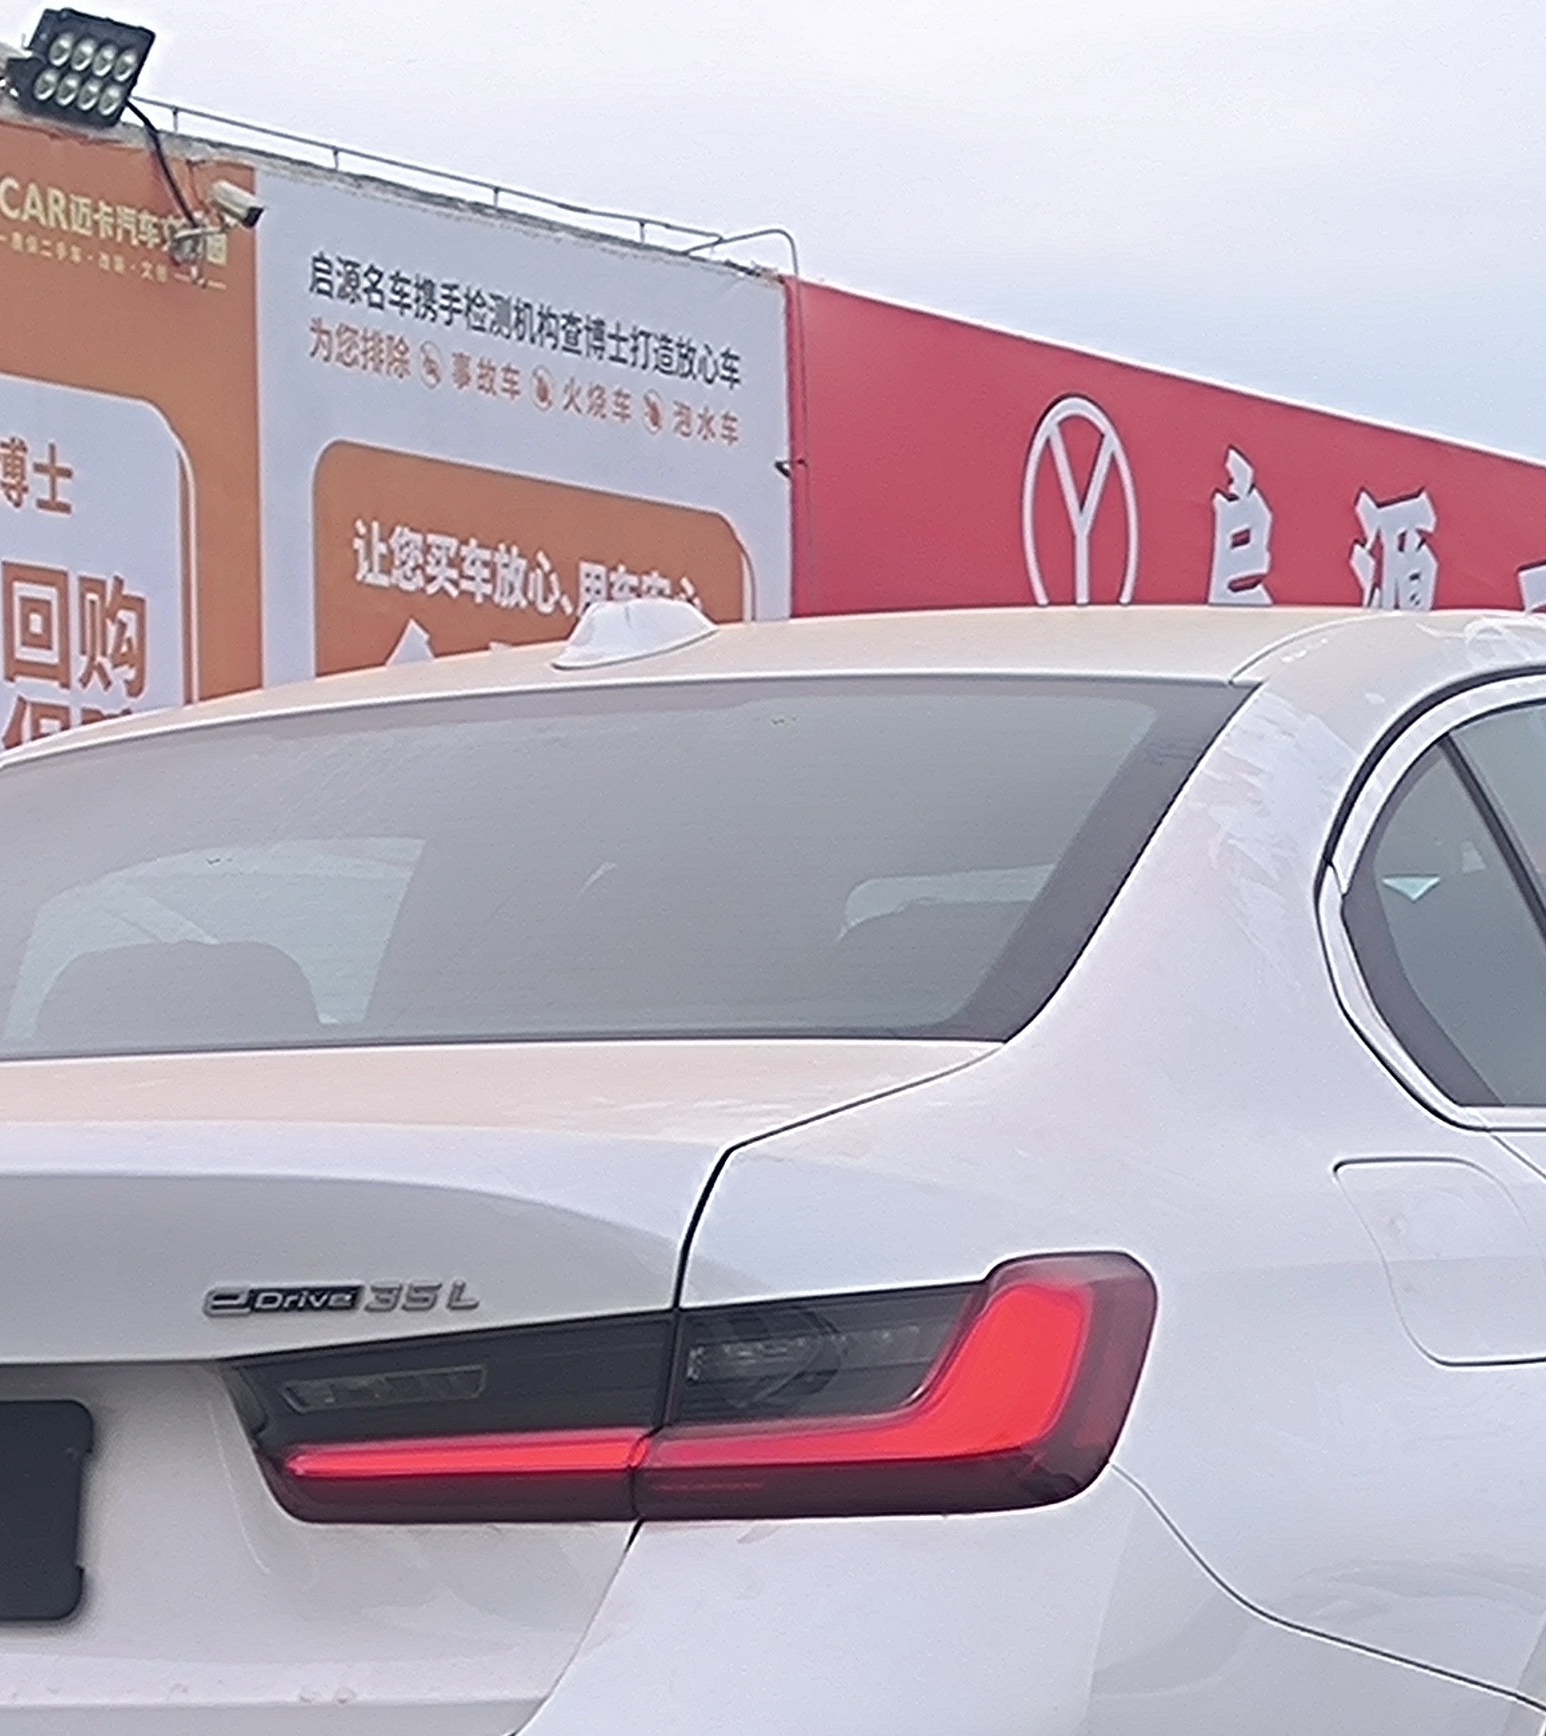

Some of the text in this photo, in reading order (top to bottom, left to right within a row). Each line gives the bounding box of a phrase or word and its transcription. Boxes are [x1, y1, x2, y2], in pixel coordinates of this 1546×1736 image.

[309, 251, 742, 389] 启源名车携手检测机构查博士打造放心车
[309, 317, 739, 446] 为您排除 事故车 火烧车 泡水车
[1, 559, 147, 698] 回购
